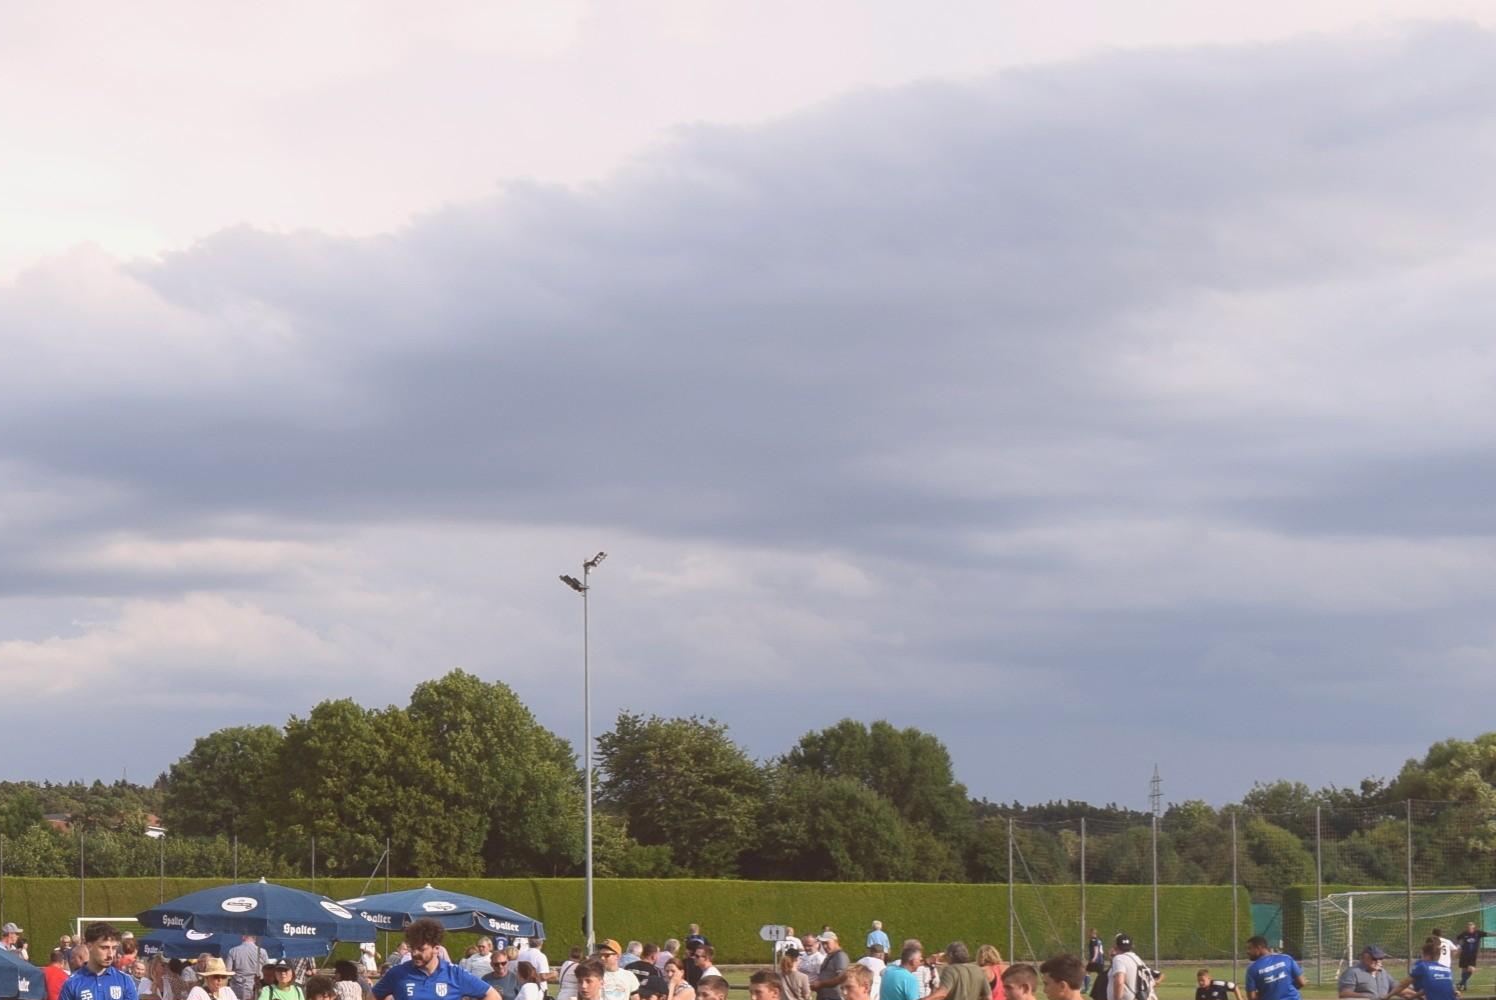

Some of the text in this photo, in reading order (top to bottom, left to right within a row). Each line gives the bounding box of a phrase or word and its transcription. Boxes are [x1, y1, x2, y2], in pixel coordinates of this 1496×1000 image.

[162, 914, 185, 927] Spalter
[488, 918, 520, 932] Spalter
[283, 922, 317, 936] Spalter
